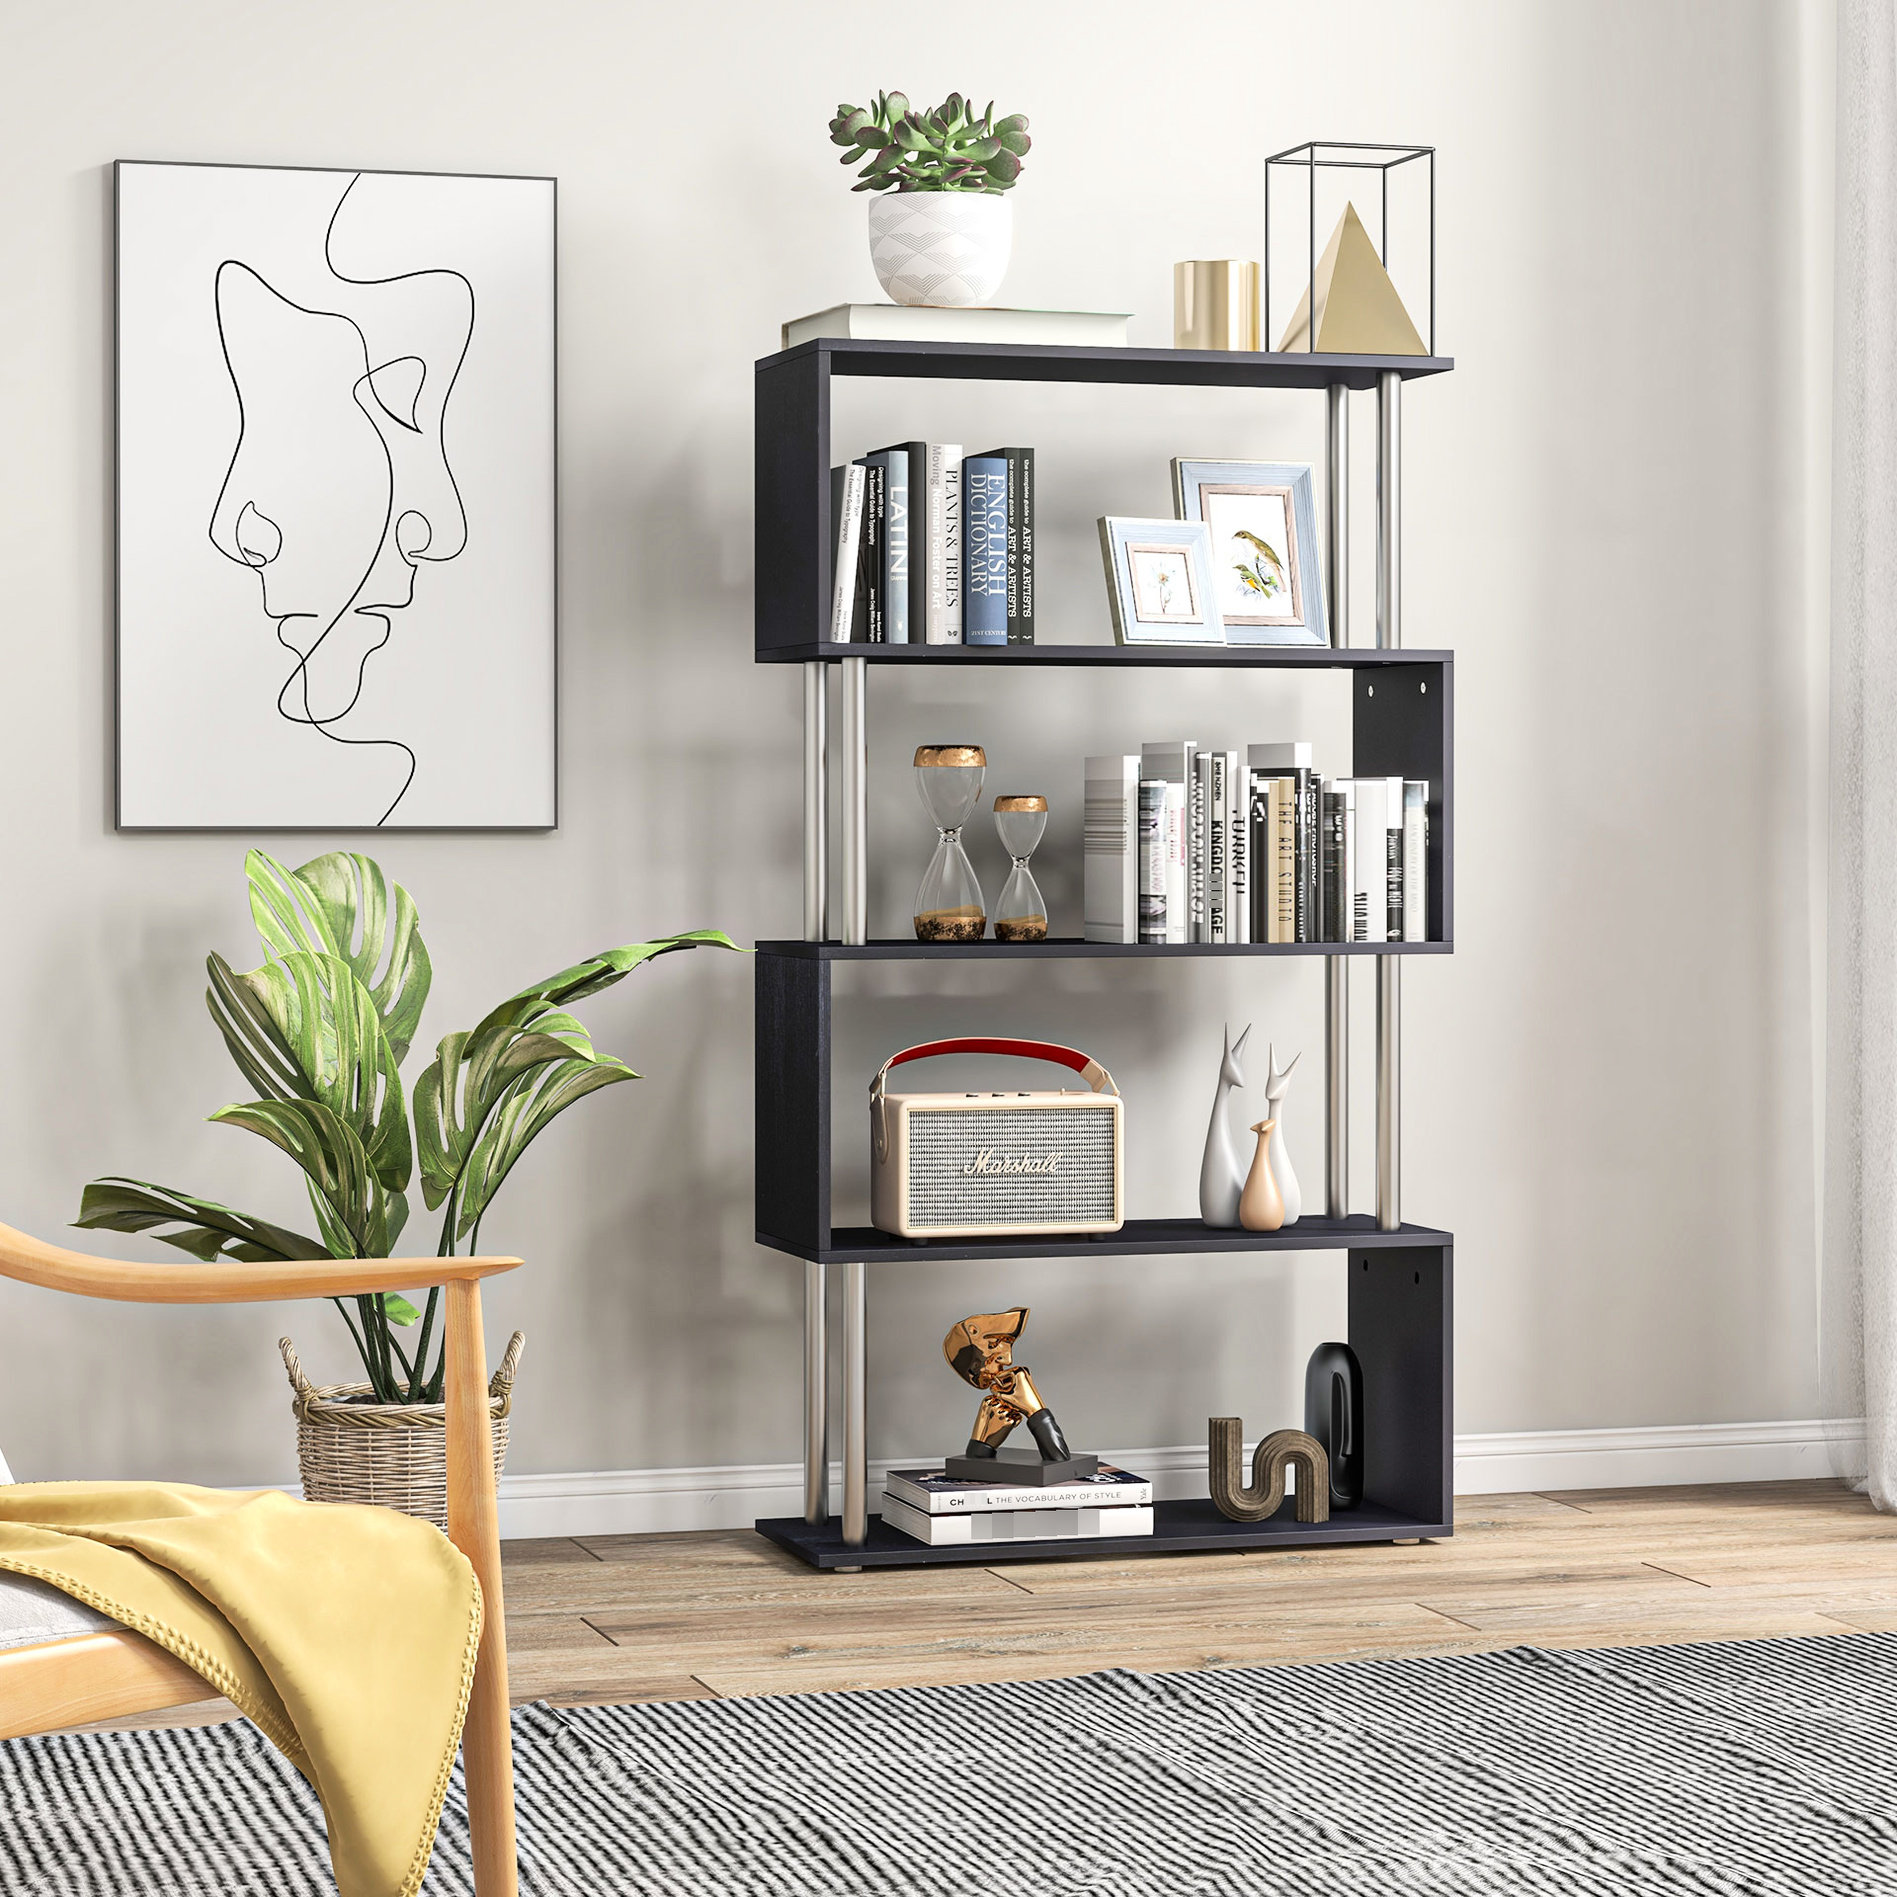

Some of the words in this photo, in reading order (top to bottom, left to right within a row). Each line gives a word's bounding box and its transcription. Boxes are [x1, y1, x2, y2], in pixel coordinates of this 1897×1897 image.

[930, 445, 941, 486] Moving
[932, 488, 942, 533] Norman
[945, 470, 958, 533] PLANTS
[890, 486, 908, 573] LATIN
[945, 537, 958, 549] &
[970, 473, 988, 597] DICTIONARY
[987, 473, 1007, 596] ENGLISH
[1008, 526, 1017, 552] ART
[1023, 526, 1032, 552] ART
[932, 536, 942, 572] Foster
[1008, 553, 1017, 564] &
[1023, 553, 1032, 564] &
[932, 574, 941, 589] on
[946, 553, 959, 607] TREES
[1008, 566, 1017, 618] ARTISTS
[1023, 566, 1032, 618] ARTISTS
[932, 592, 942, 609] Art
[1279, 837, 1292, 860] ART
[964, 1148, 1063, 1174] Marshall
[1015, 1493, 1077, 1503] VOCABULARY
[1080, 1492, 1092, 1500] OF
[1094, 1491, 1121, 1499] STYLE
